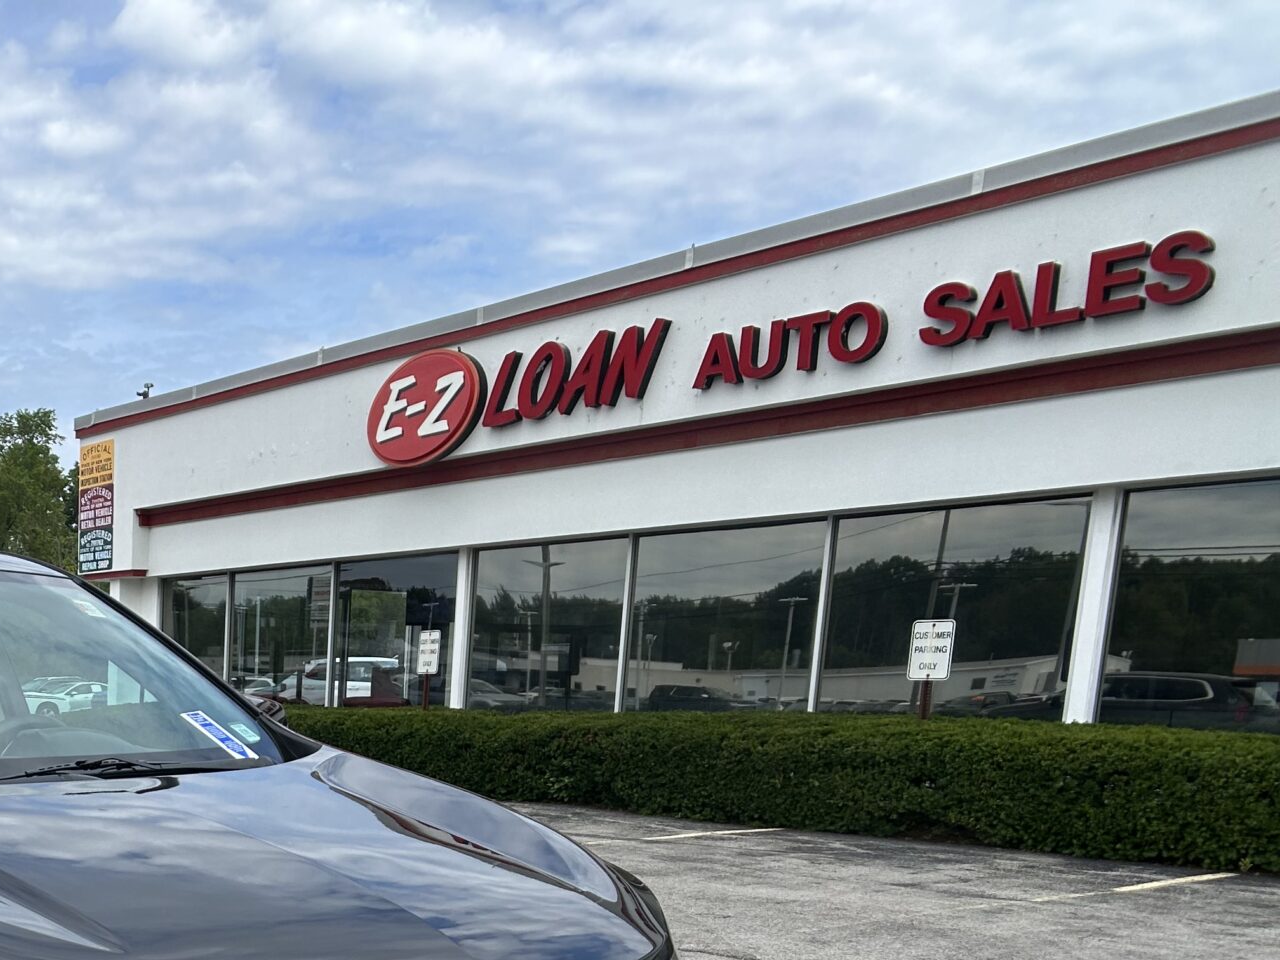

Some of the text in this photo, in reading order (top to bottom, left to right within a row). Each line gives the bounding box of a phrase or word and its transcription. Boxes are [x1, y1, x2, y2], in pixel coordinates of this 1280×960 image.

[375, 229, 1215, 444] E-Z LOAN AUTO SALES
[82, 444, 111, 461] OFFICIAL
[95, 462, 112, 473] VEHICLE
[81, 487, 112, 505] REGISTERED
[81, 530, 112, 545] REGISTERED
[918, 662, 938, 670] ONLY
